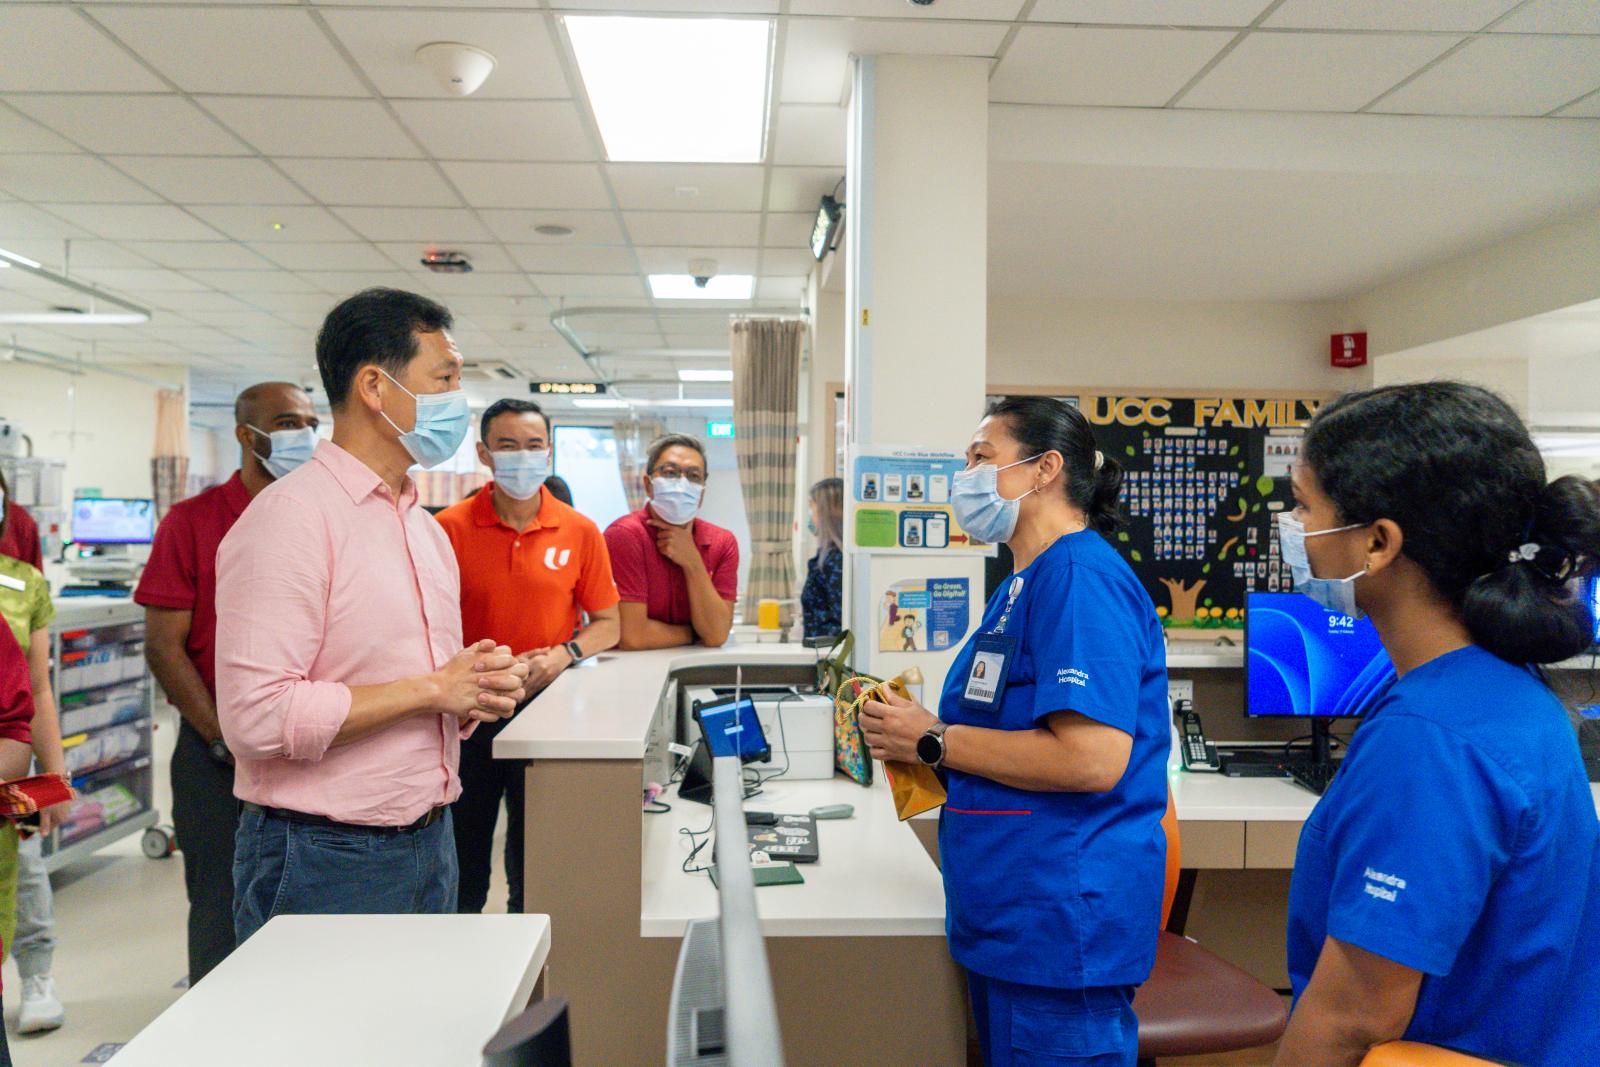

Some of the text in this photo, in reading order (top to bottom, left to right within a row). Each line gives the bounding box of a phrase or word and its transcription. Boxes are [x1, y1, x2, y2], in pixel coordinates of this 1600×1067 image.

[1089, 397, 1172, 426] UCC
[1328, 615, 1354, 628] 9:42
[1056, 668, 1089, 680] Alexandra
[1058, 676, 1086, 687] Hospital
